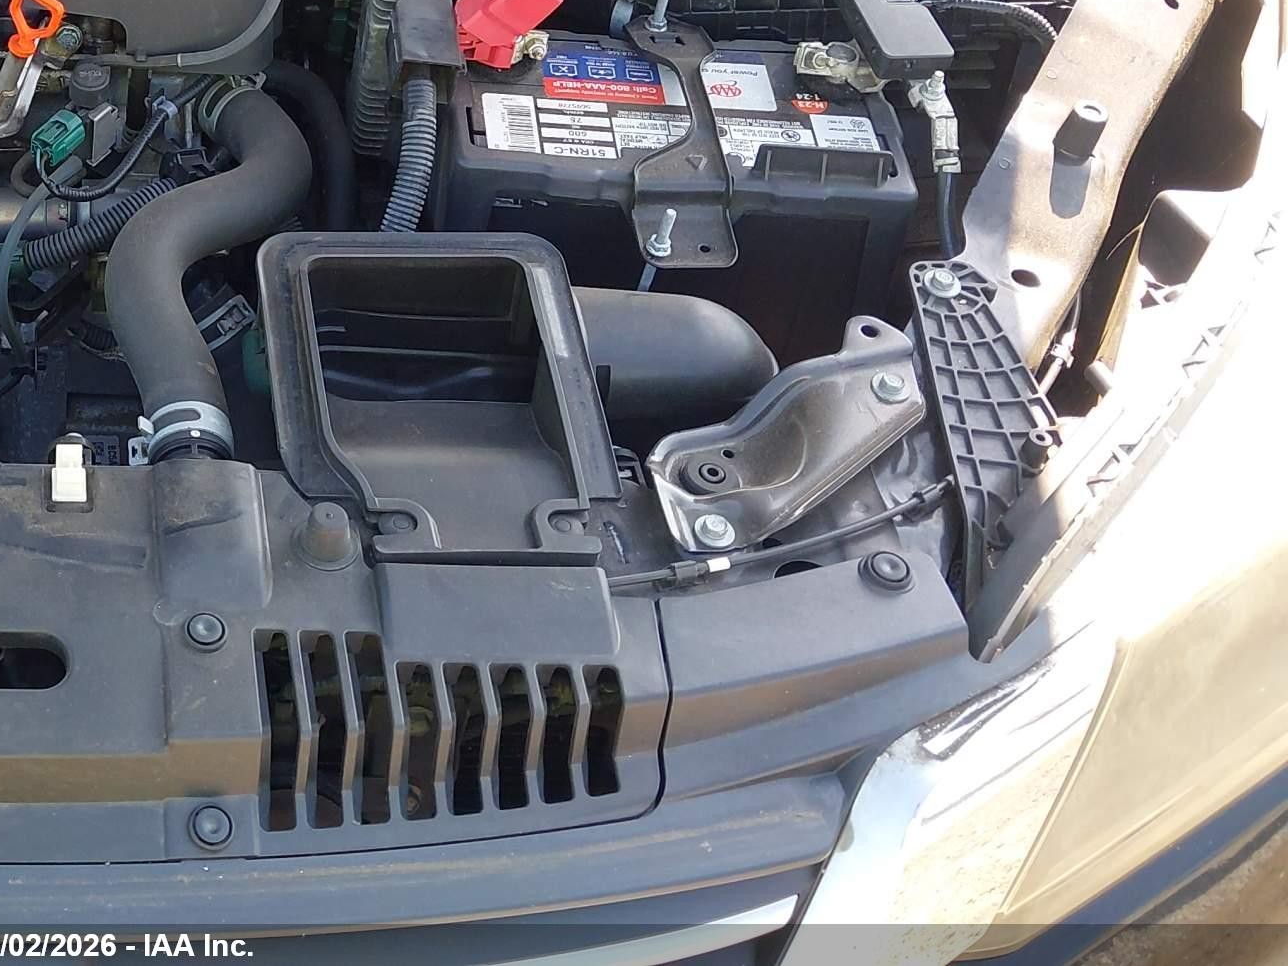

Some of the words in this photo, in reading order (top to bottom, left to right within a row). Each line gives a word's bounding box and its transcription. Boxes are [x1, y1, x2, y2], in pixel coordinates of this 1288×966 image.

[552, 80, 631, 92] 800-AAA-HELP
[633, 86, 657, 94] Call:
[711, 84, 739, 97] AAA
[553, 146, 606, 157] 51RN-C
